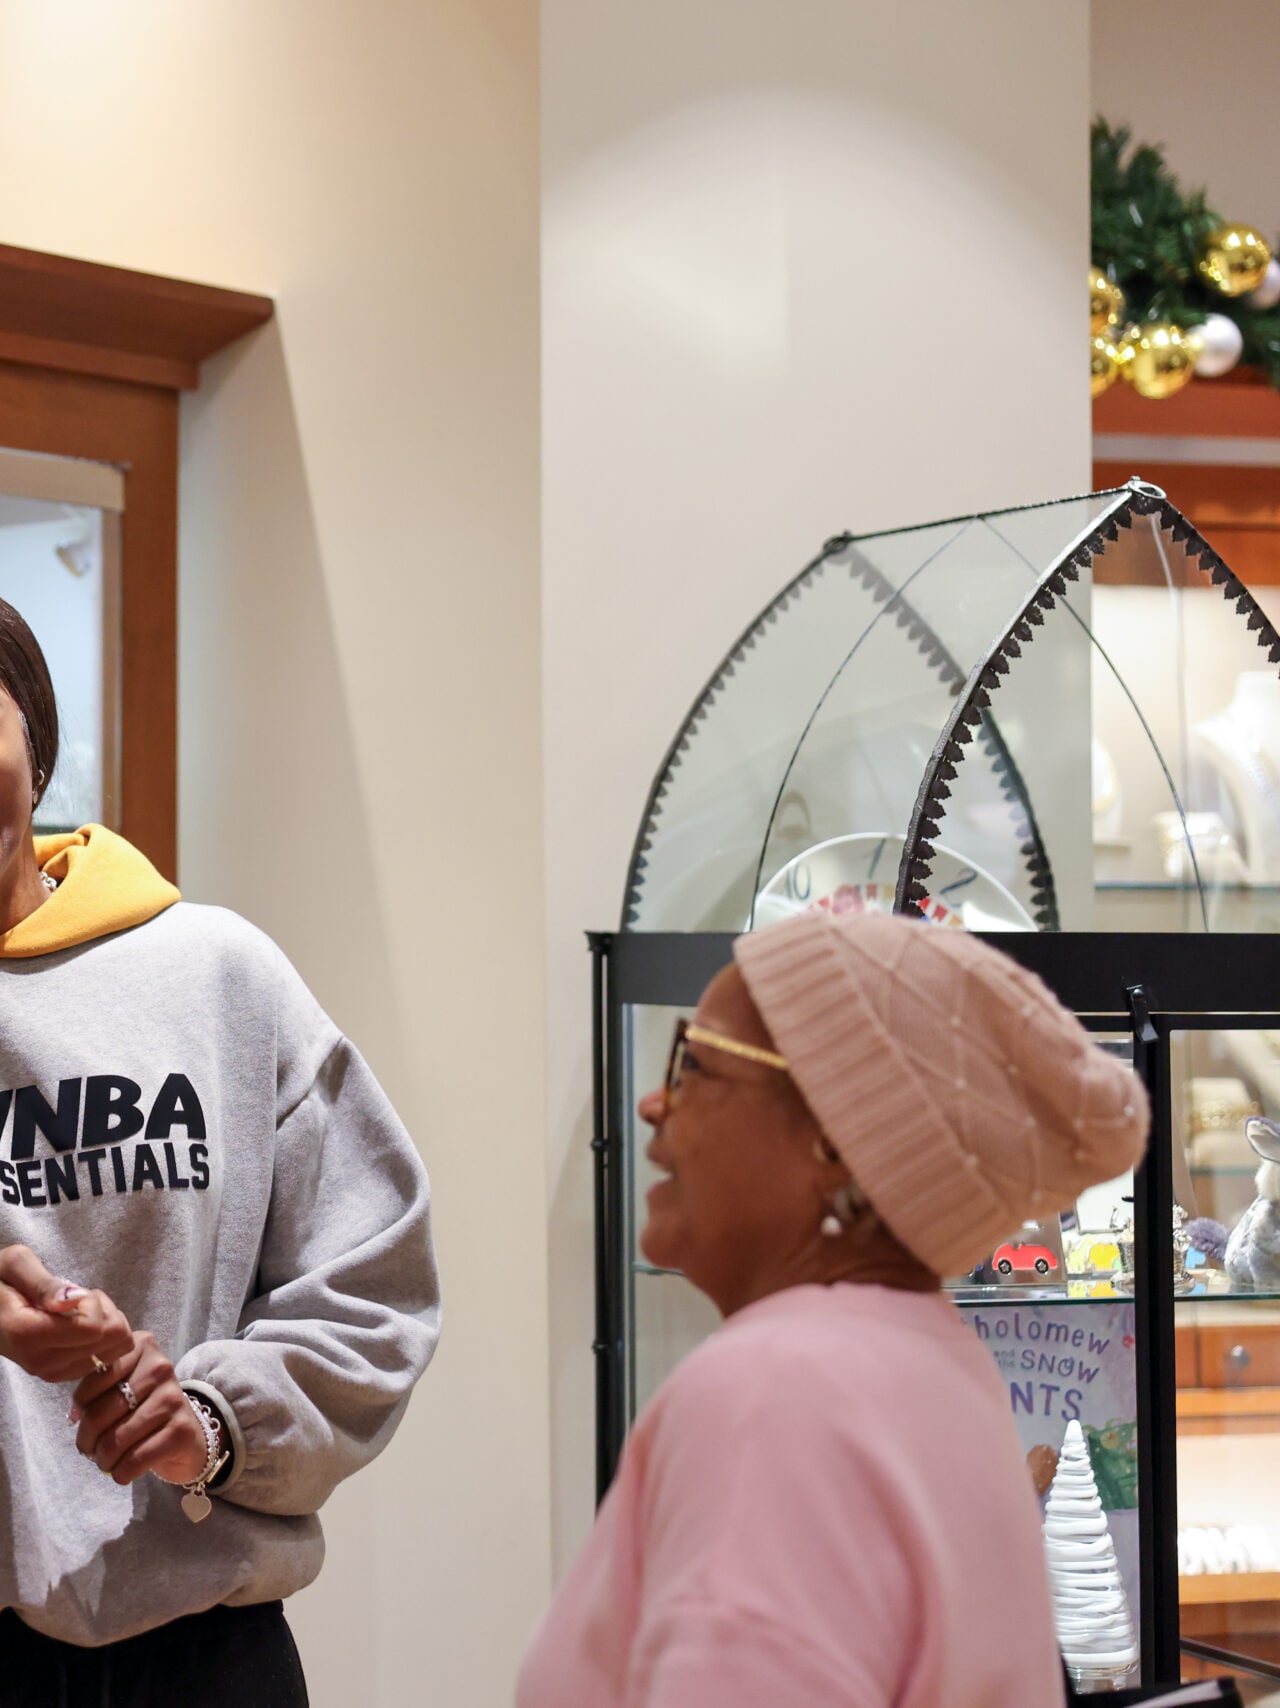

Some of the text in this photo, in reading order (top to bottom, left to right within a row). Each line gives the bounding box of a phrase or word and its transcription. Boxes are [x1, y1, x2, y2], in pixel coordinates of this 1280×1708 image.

[960, 1311, 1111, 1355] holomew
[1021, 1349, 1100, 1384] SNOW
[1010, 1380, 1084, 1423] NTS
